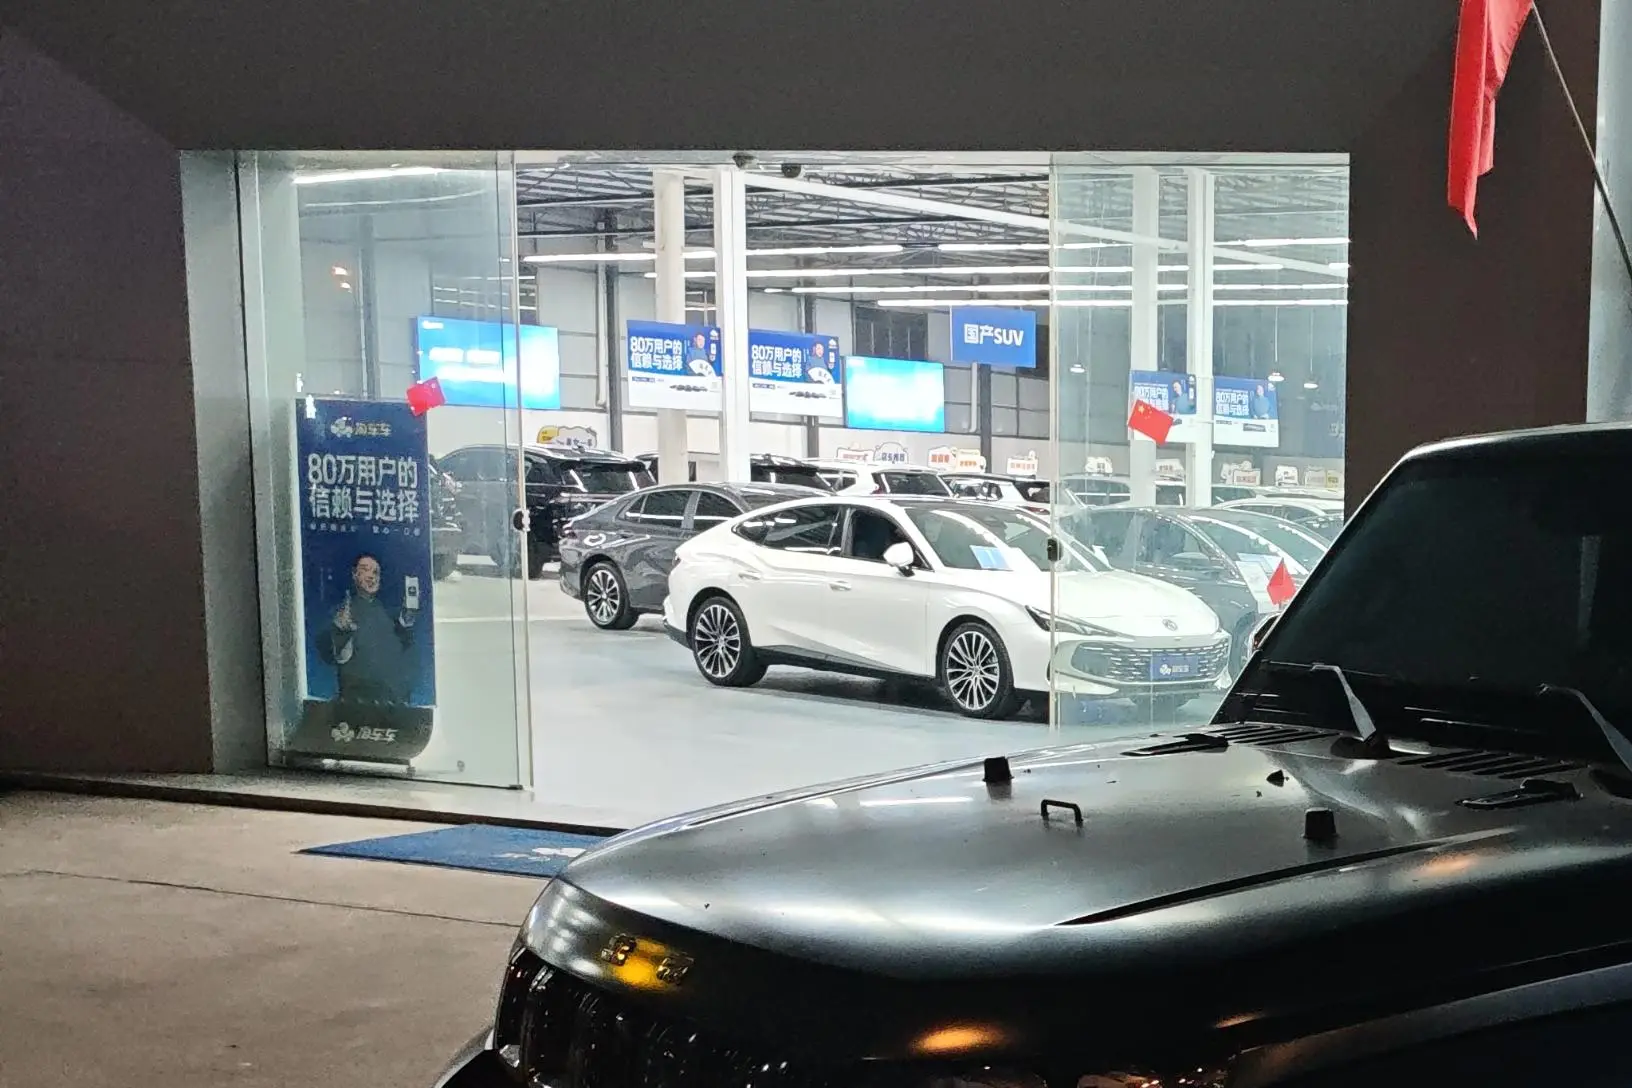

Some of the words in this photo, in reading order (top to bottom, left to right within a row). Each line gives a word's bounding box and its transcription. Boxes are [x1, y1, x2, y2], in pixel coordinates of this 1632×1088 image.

[630, 336, 682, 355] 80万用户的
[964, 323, 1024, 347] 国产SUV
[752, 345, 802, 363] 80万用户的
[308, 453, 418, 489] 80万用户的
[308, 485, 419, 523] 信赖与选择
